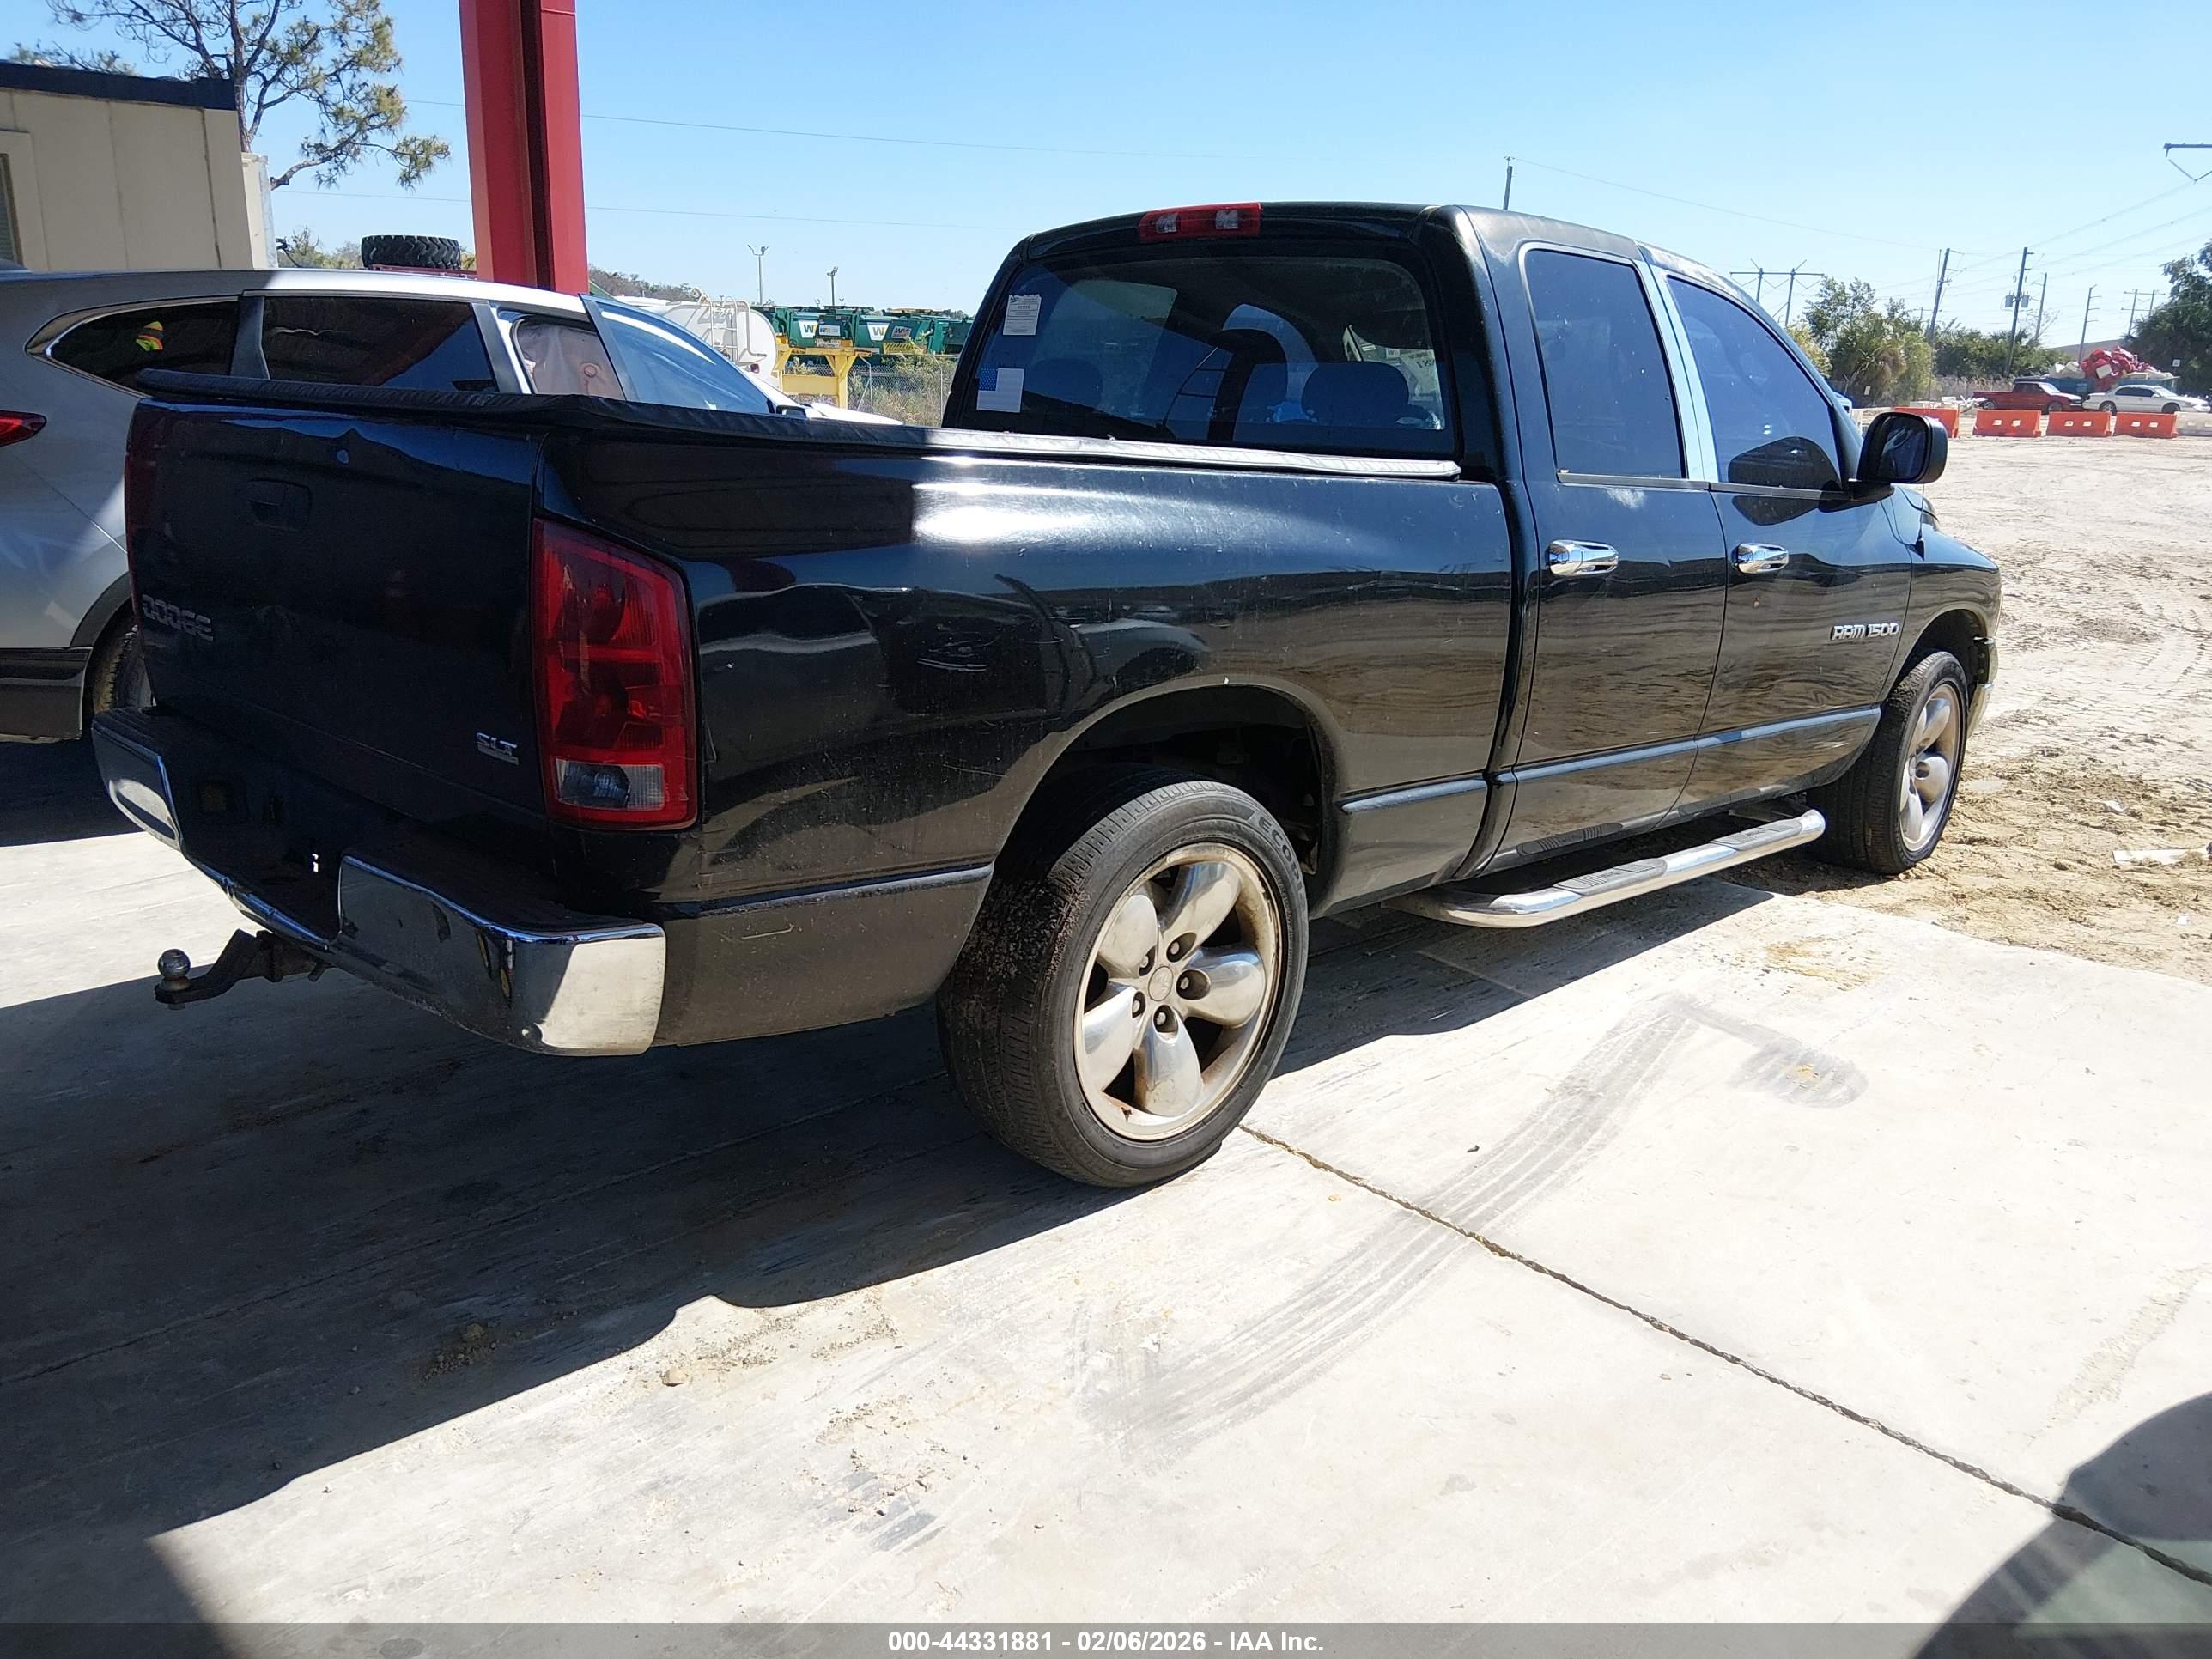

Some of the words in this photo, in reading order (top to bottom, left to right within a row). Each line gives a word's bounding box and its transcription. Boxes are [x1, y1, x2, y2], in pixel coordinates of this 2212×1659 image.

[1830, 623, 1866, 641] RAM
[1866, 622, 1899, 638] 1500
[476, 732, 518, 757] SLT
